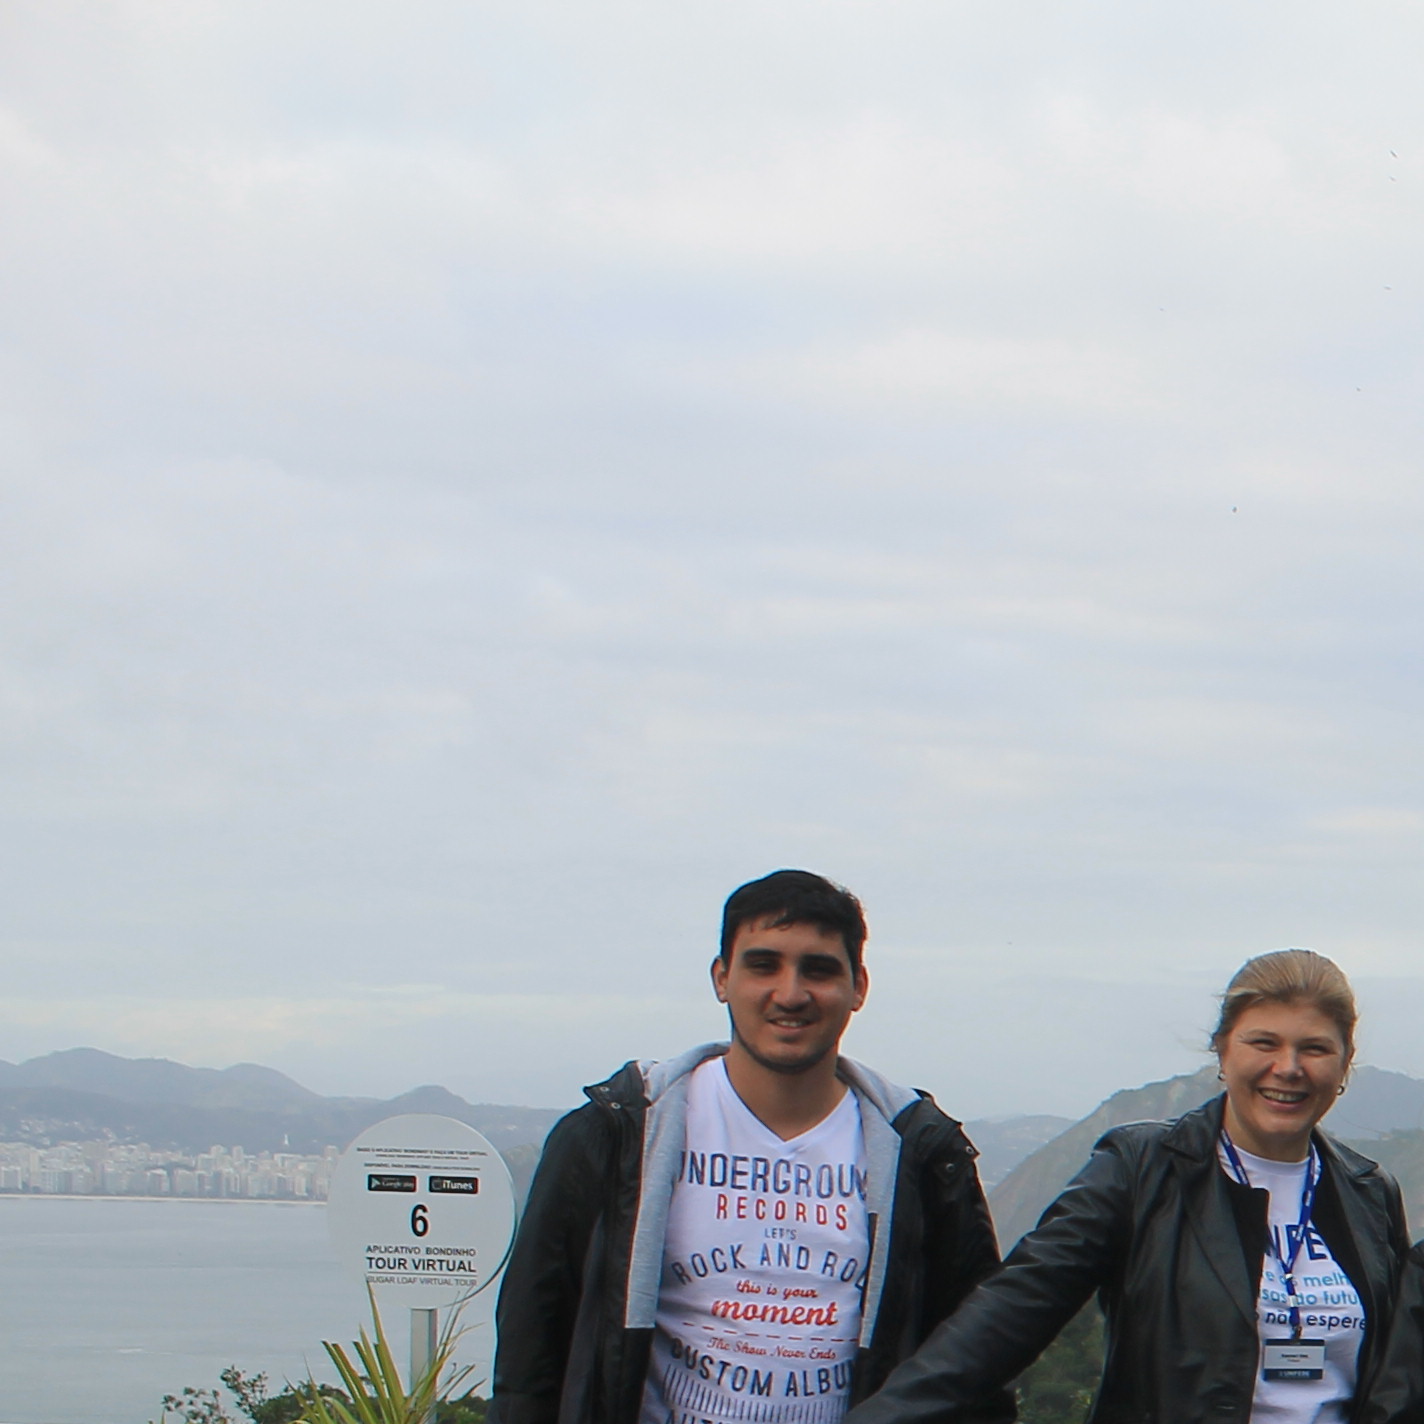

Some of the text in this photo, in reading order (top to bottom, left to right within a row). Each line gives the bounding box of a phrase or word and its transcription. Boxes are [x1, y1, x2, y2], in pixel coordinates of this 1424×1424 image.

[443, 1179, 473, 1190] iTunes
[411, 1204, 429, 1237] 6
[716, 1193, 847, 1230] RECORDS
[765, 1227, 797, 1240] LET'S
[366, 1245, 476, 1257] APLICATIVO BONDINHO
[366, 1257, 477, 1272] TOUR VIRTUAL
[671, 1244, 746, 1285] ROCK
[760, 1242, 811, 1271] AND
[367, 1275, 477, 1287] SUGAR LOAF VIRTUAL TOUR
[736, 1280, 819, 1301] this is your
[711, 1300, 839, 1326] moment
[1265, 1308, 1289, 1325] nã
[707, 1337, 837, 1360] The Show Never Ends
[670, 1337, 853, 1398] CUSTOM ALBU
